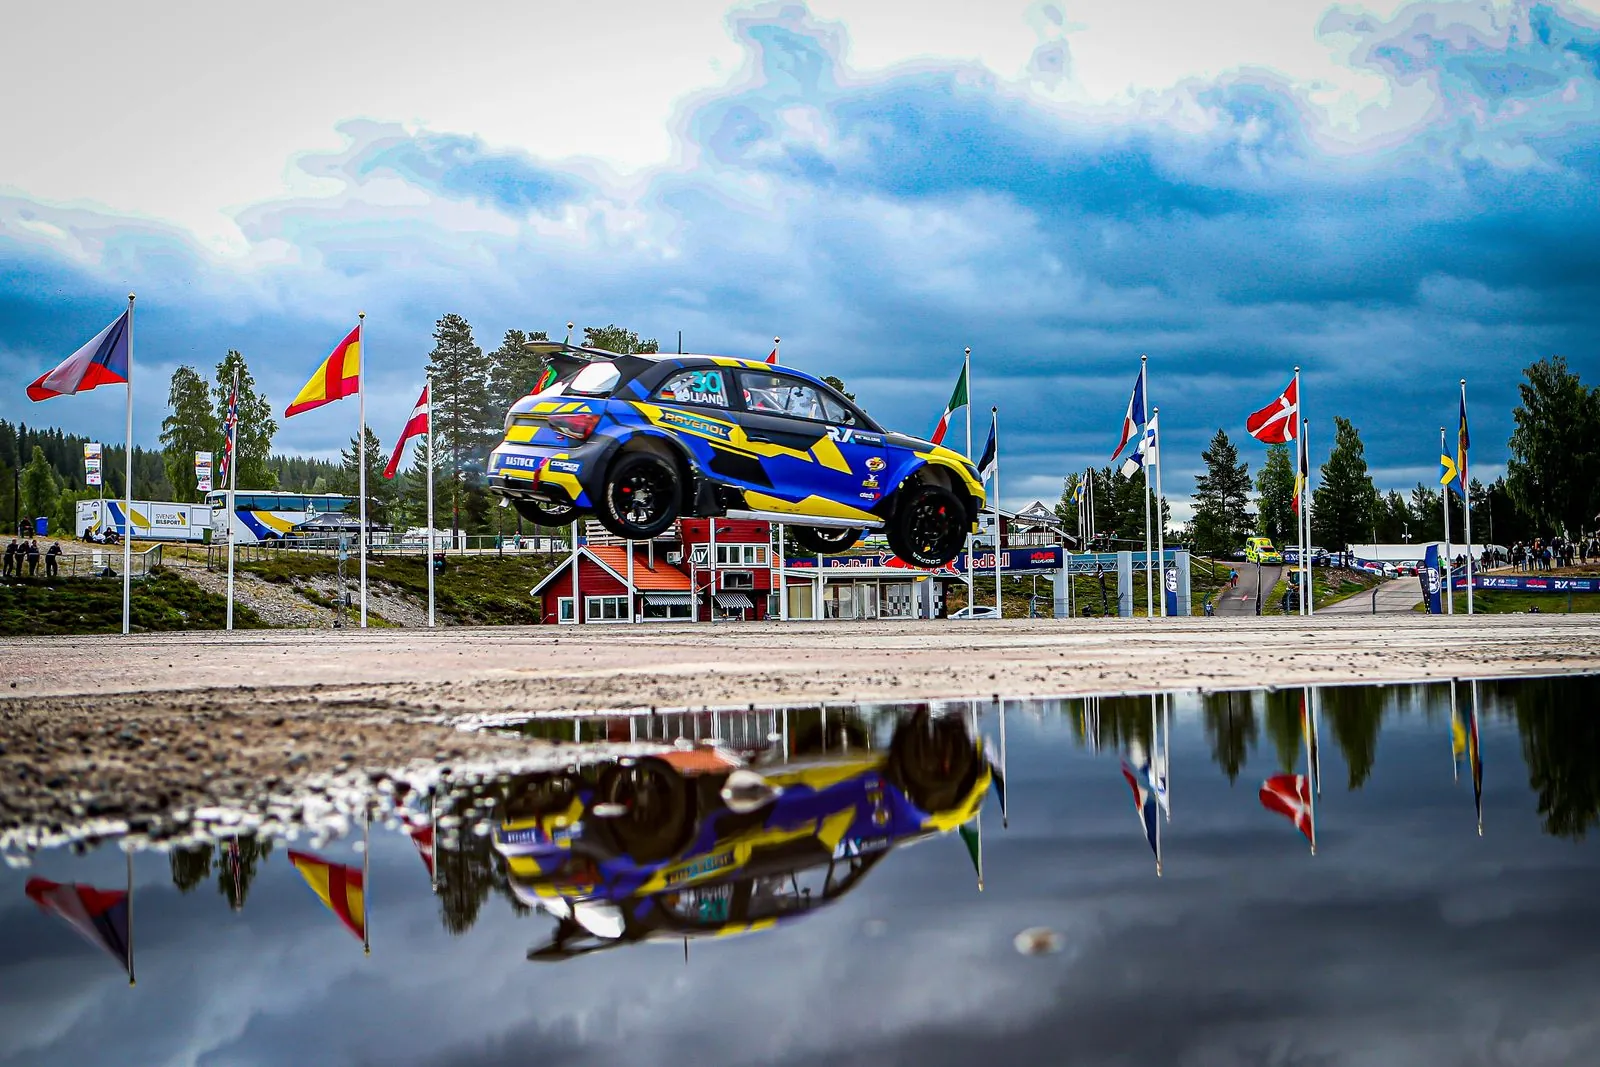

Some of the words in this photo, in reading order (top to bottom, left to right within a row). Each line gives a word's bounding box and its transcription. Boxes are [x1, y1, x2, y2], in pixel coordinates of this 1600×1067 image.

[691, 371, 722, 393] 30
[664, 412, 727, 436] RAVENOL
[505, 456, 535, 468] BASTUCK
[550, 460, 580, 469] COOPER
[1483, 578, 1497, 587] RX
[1554, 580, 1568, 589] RX
